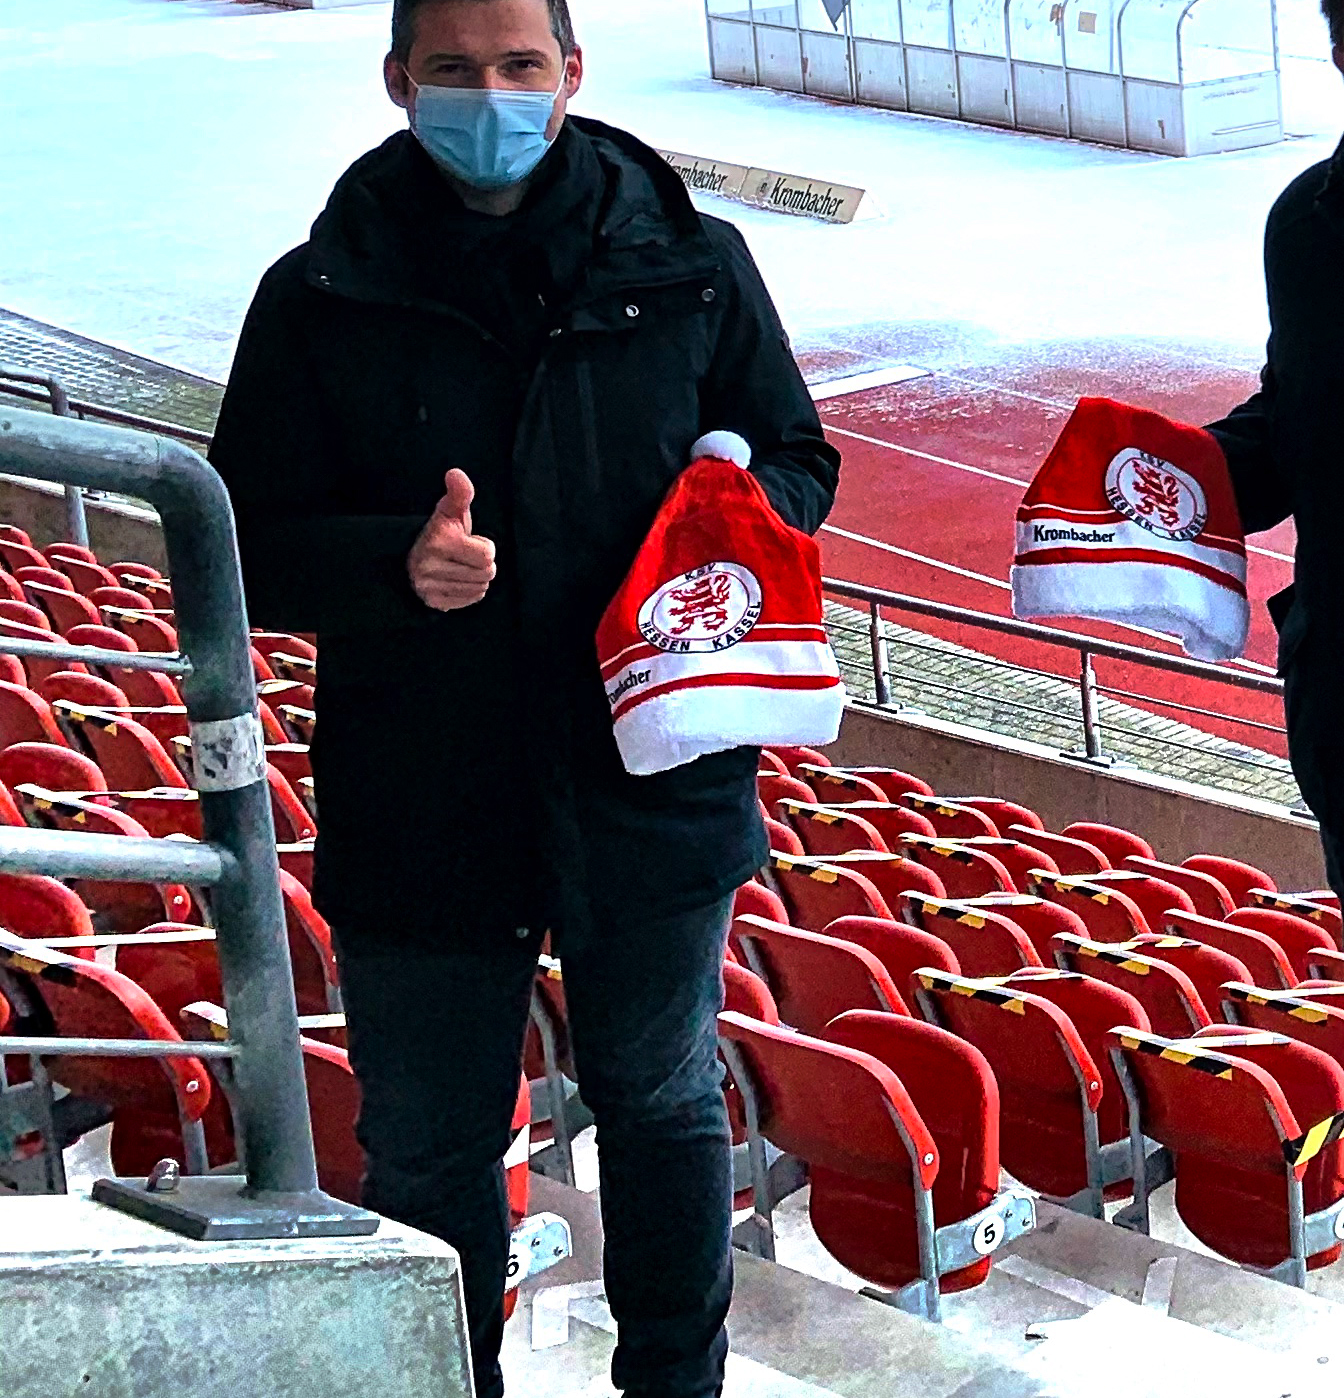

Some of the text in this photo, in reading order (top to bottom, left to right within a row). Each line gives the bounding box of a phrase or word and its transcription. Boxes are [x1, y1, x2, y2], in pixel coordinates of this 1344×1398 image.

[770, 177, 844, 216] Krombacher
[1034, 525, 1115, 543] Krombacher
[641, 621, 690, 651] HESSEN
[712, 602, 761, 650] KASSEL
[984, 1223, 996, 1244] 5
